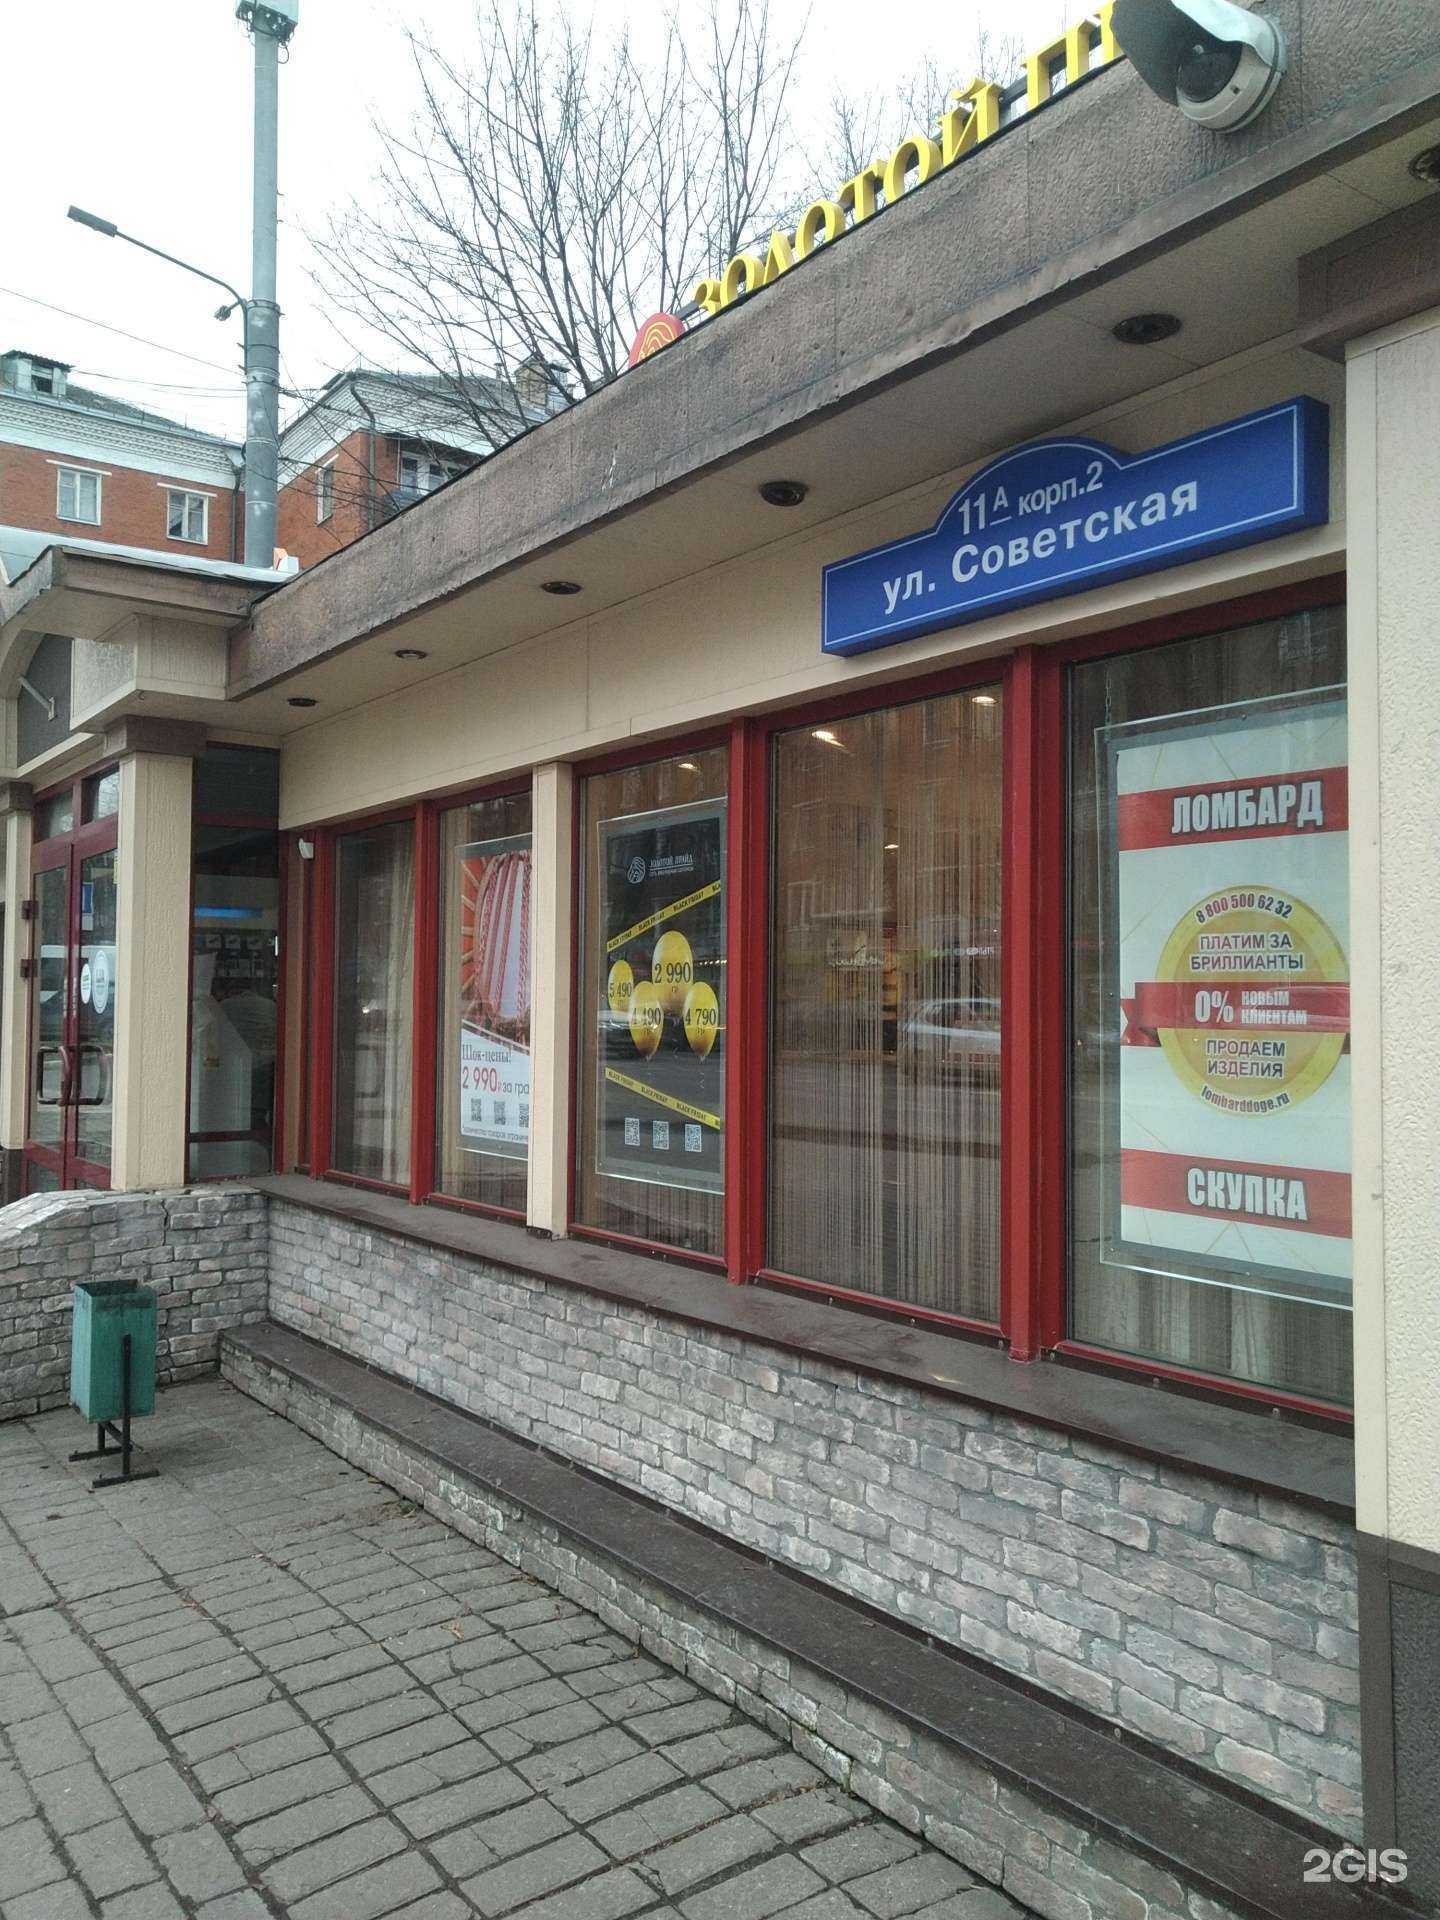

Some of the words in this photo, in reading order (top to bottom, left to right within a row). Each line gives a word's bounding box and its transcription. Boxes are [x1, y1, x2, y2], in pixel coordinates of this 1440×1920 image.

[694, 77, 1004, 316] ЗОЛОТОЙ
[1018, 461, 1104, 516] корп.2
[882, 570, 936, 615] ул.
[951, 480, 1198, 583] Советская
[1171, 780, 1324, 834] ЛОМБАРД
[1196, 910, 1206, 923] 8
[1205, 897, 1229, 917] 800
[1231, 893, 1255, 908] 500
[1257, 894, 1274, 911] 62
[1275, 900, 1293, 918] 32
[1200, 934, 1265, 950] ПЛАТИМ
[1270, 933, 1293, 949] ЗА
[666, 962, 691, 983] 990
[1191, 954, 1304, 970] БРИЛЛИАНТЫ
[1195, 990, 1234, 1023] 0%
[1241, 990, 1290, 1006] НОВЫМ
[695, 1008, 717, 1026] 790
[1241, 1009, 1308, 1025] КЛИЕНТАМ
[1206, 1040, 1286, 1058] ПРОДАЕМ
[462, 1065, 469, 1089] 2
[1207, 1060, 1284, 1078] ИЗДЕЛИЯ
[1201, 1085, 1291, 1113] lombarddoge.ru
[1186, 1167, 1308, 1221] СКУПКА
